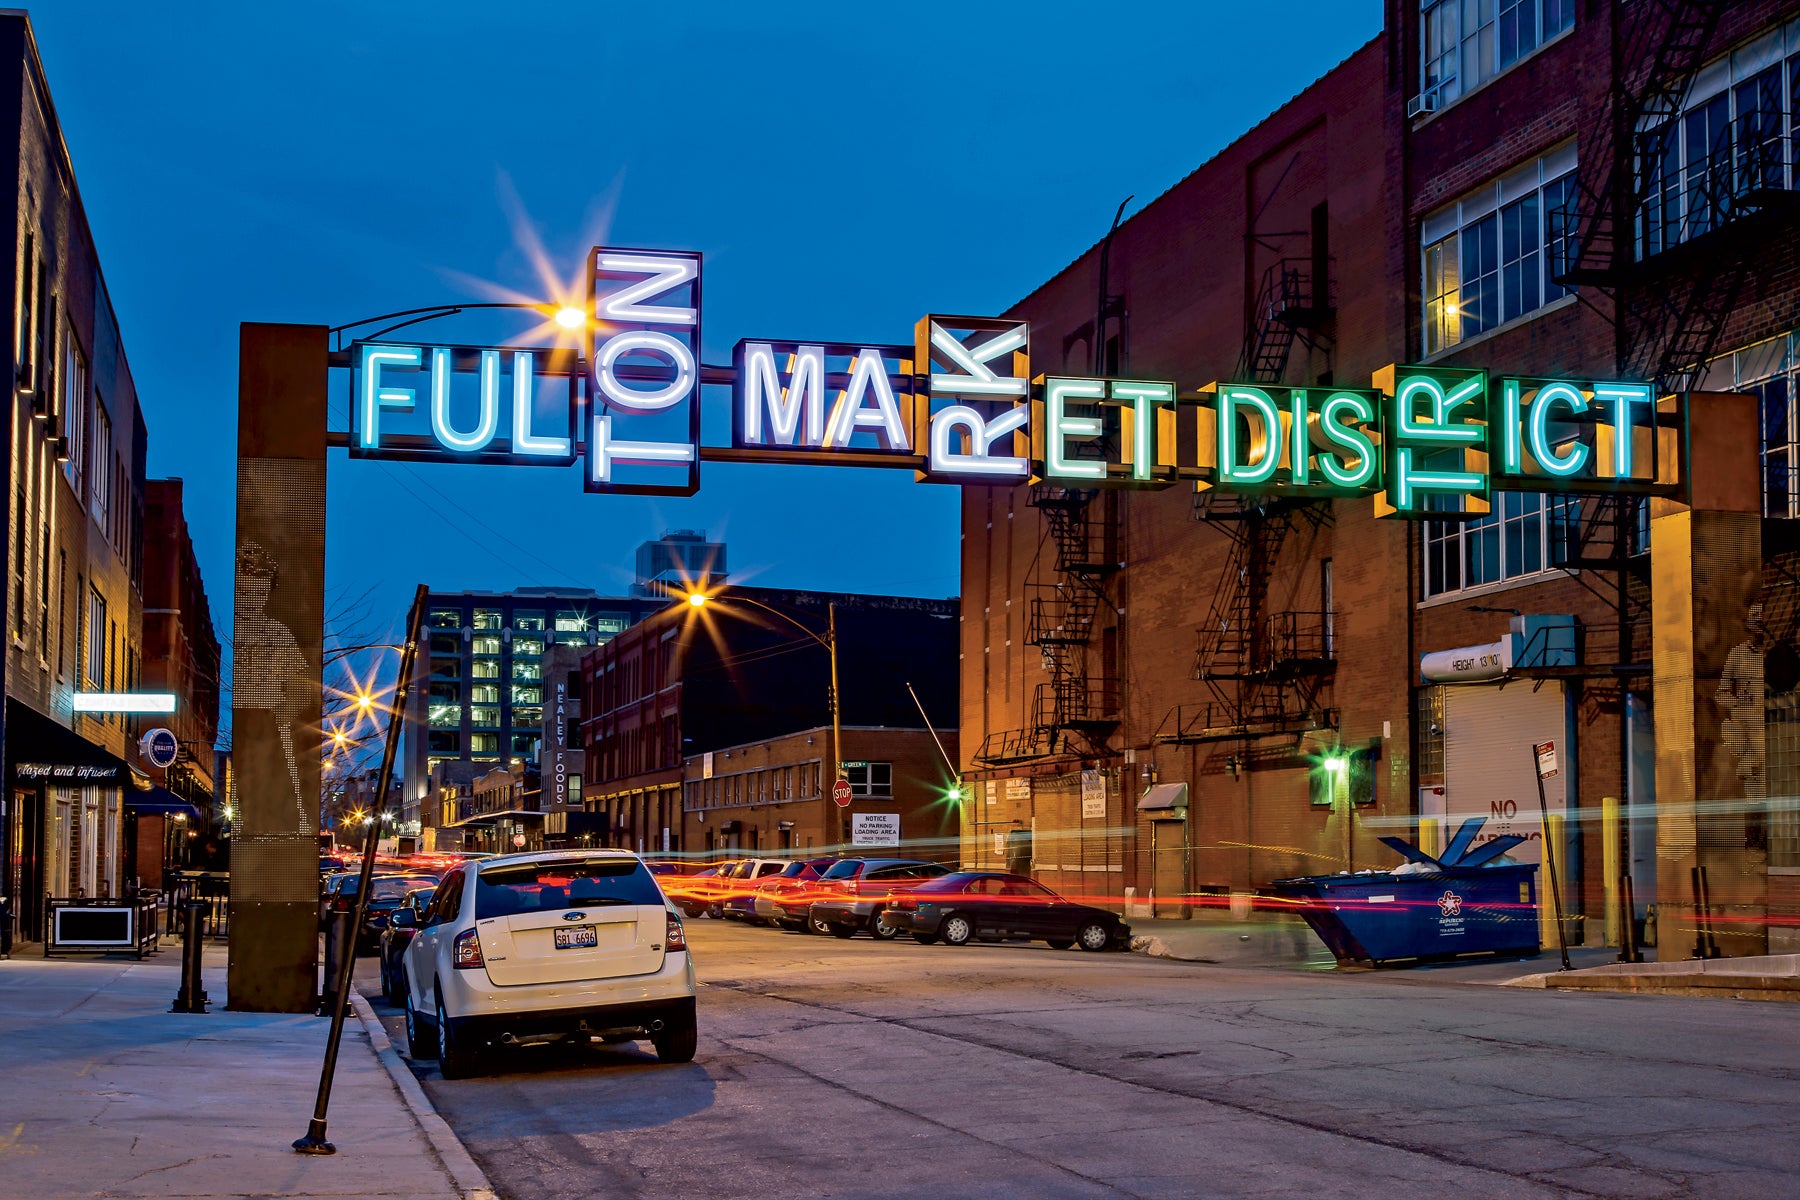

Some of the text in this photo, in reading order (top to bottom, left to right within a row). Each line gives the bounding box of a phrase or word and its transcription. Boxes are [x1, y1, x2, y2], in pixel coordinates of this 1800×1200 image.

[1452, 658, 1475, 671] HEIGHT
[555, 683, 565, 804] NEALEY FOODS
[54, 766, 76, 777] and
[77, 766, 117, 780] infused
[834, 787, 851, 799] STOP
[1490, 799, 1518, 819] NO
[557, 932, 595, 946] S81 6696
